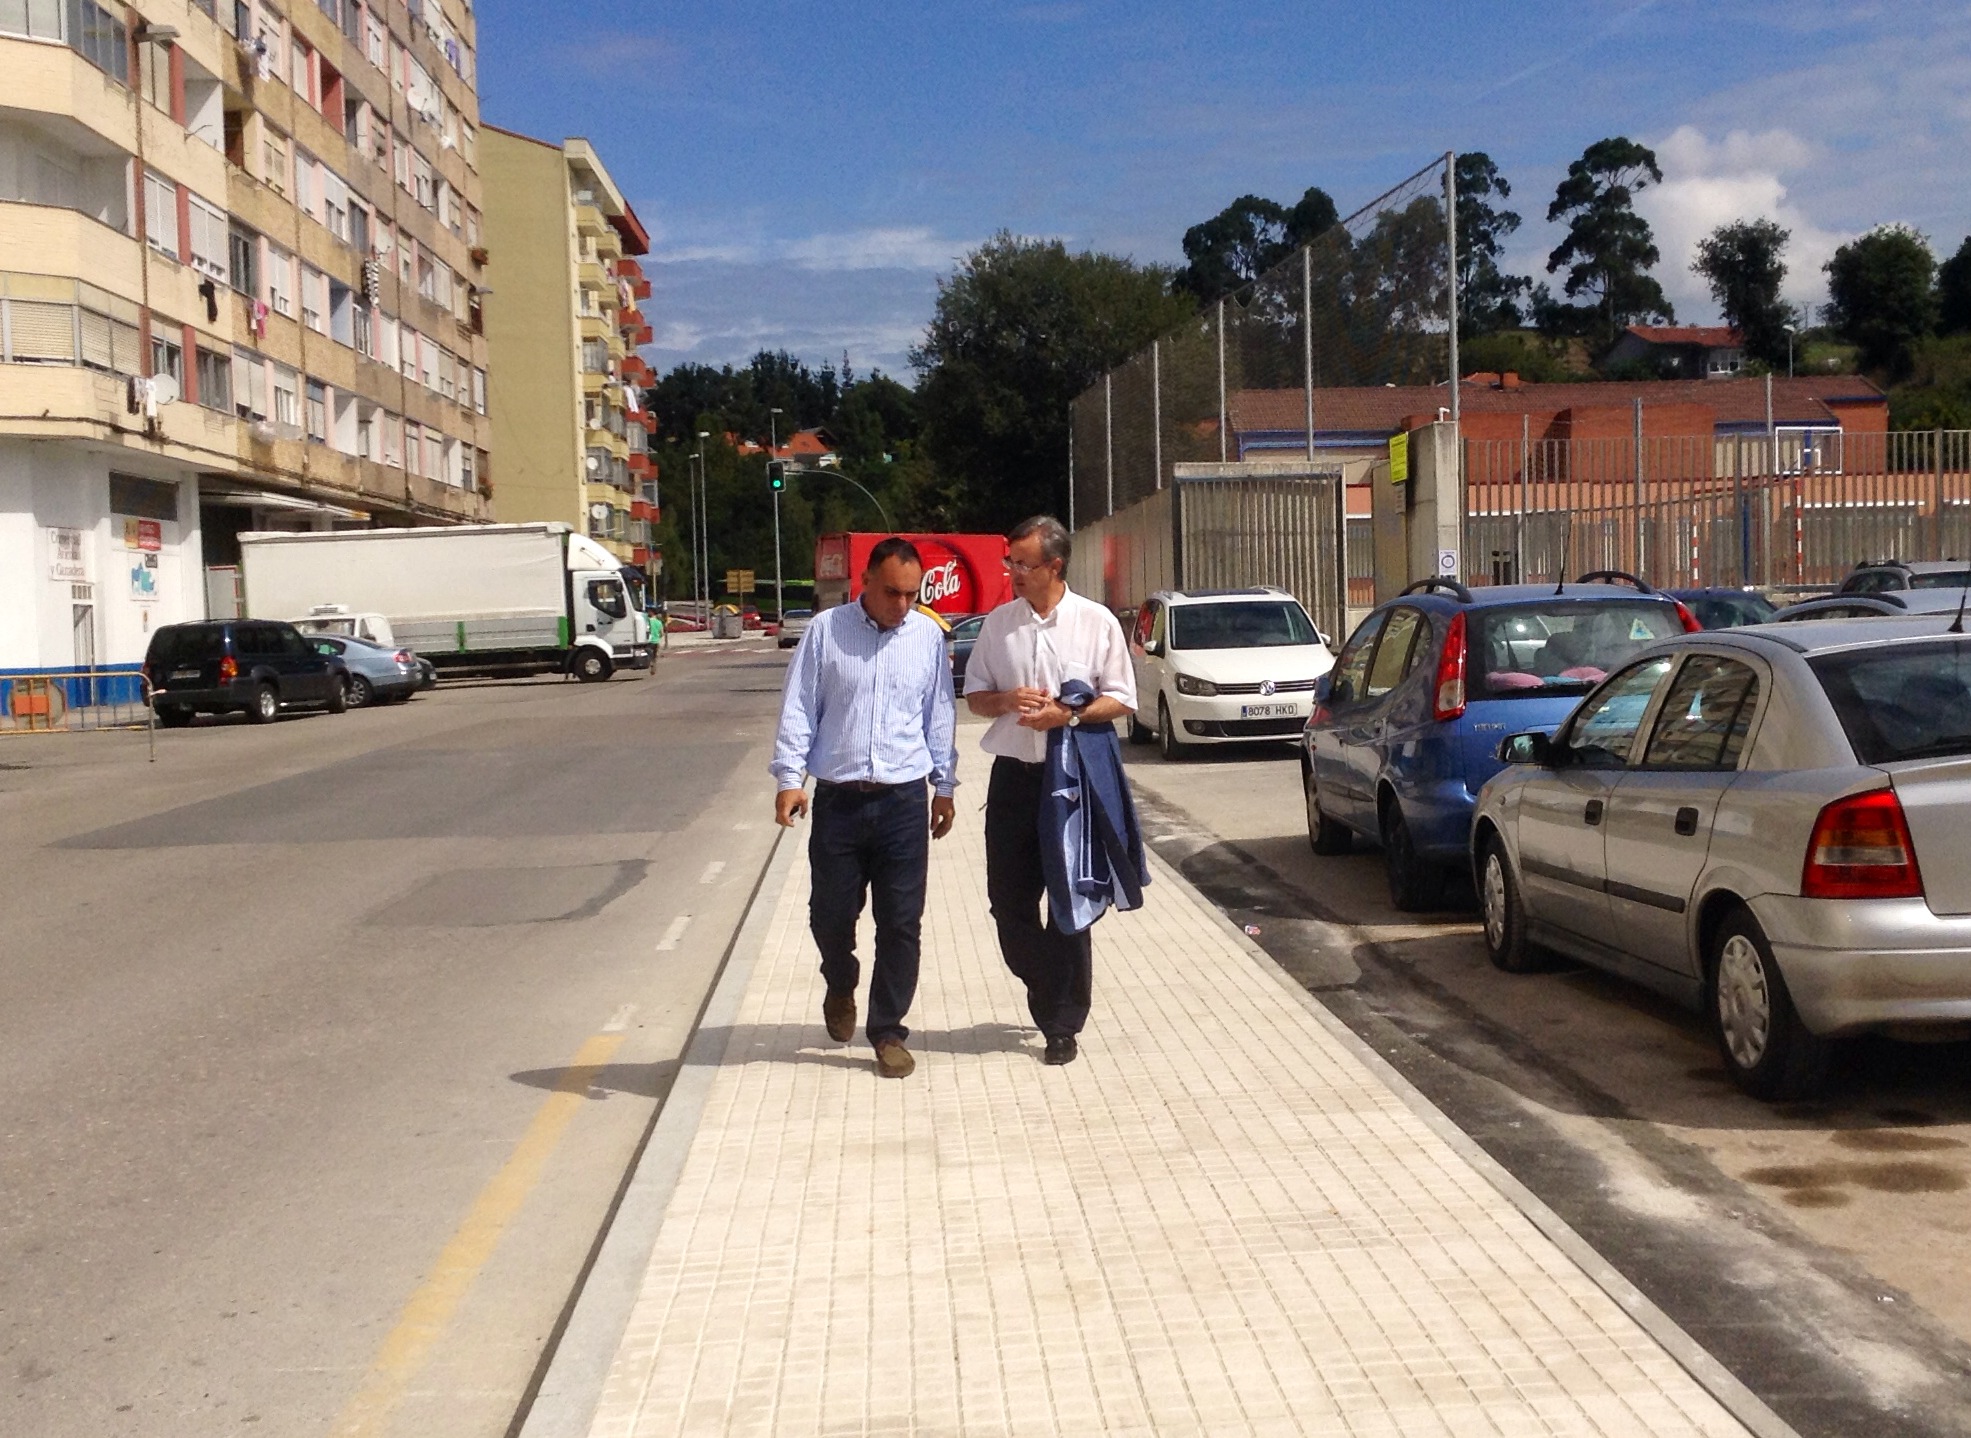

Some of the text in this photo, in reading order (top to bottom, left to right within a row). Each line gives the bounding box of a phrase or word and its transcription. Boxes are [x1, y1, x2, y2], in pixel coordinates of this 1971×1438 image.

[920, 558, 961, 605] Cola
[1248, 705, 1294, 716] 8078 HKD
